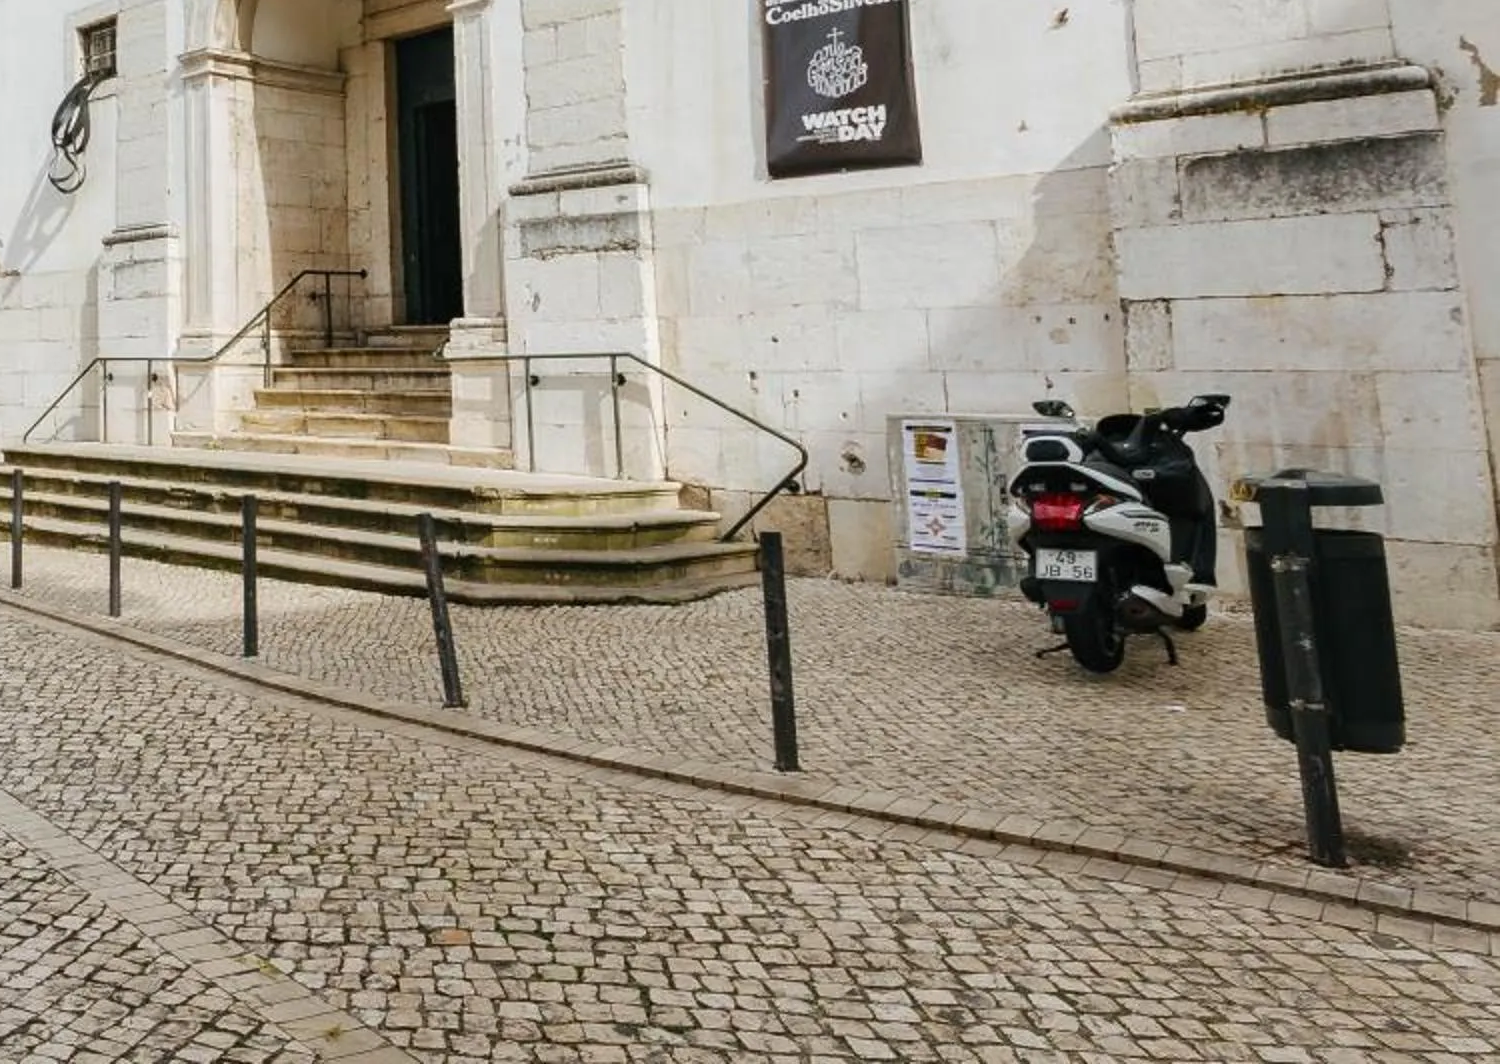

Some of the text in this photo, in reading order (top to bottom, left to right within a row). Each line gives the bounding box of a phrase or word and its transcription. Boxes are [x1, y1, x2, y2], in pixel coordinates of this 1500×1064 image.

[765, 3, 830, 25] Coelho
[801, 104, 887, 131] WATCH
[838, 122, 886, 142] DAY
[1055, 551, 1076, 565] 49
